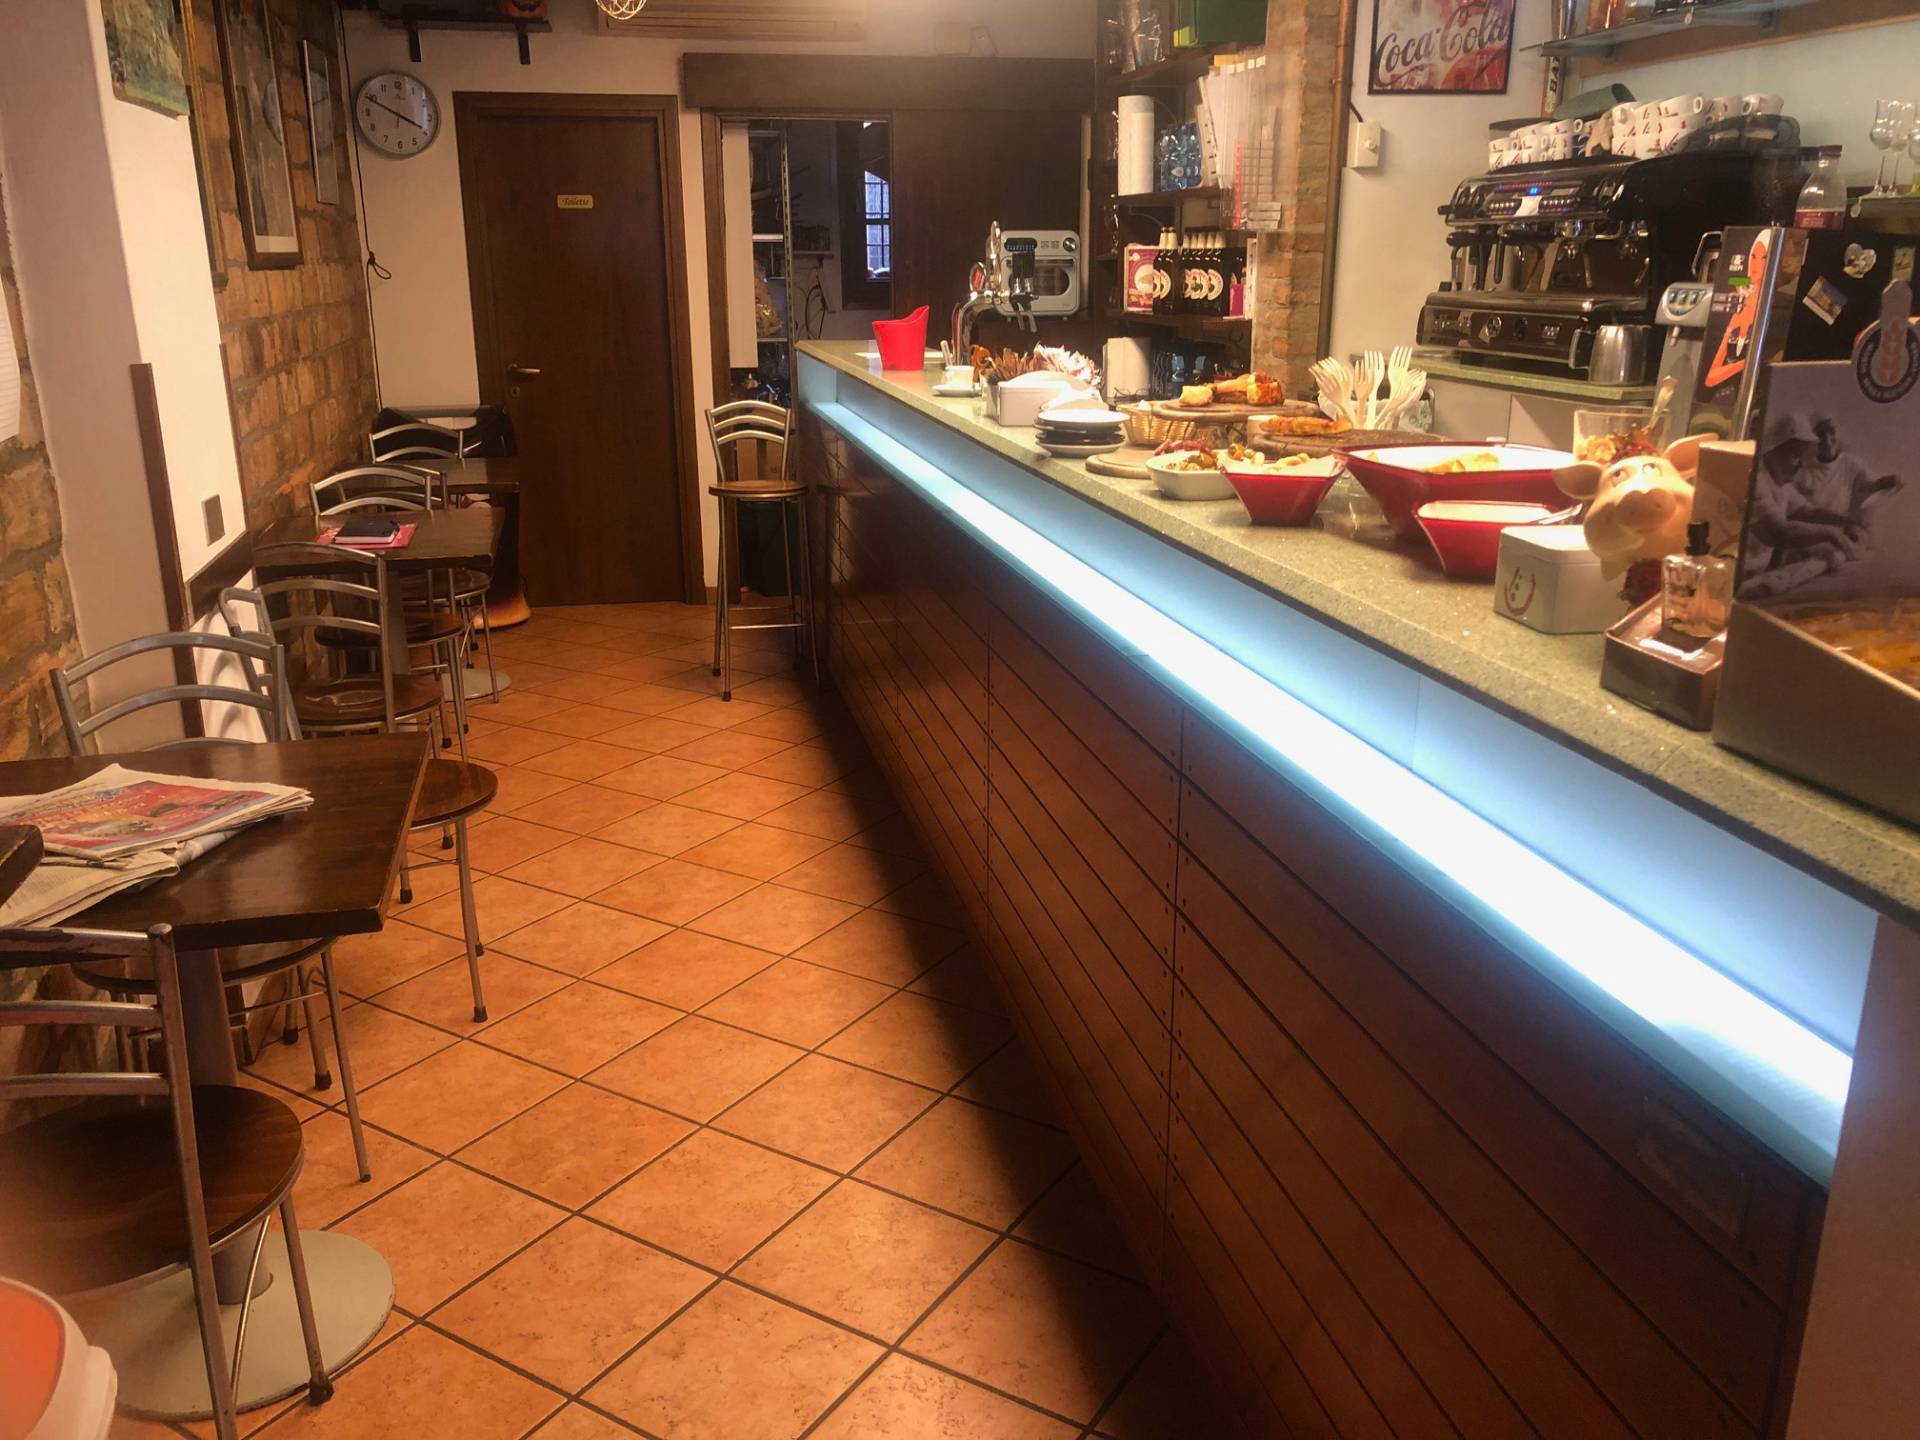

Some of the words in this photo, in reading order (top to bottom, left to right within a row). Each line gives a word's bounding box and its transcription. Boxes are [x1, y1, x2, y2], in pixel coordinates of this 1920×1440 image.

[383, 134, 389, 143] 7
[411, 137, 418, 146] 5
[397, 140, 403, 150] 6
